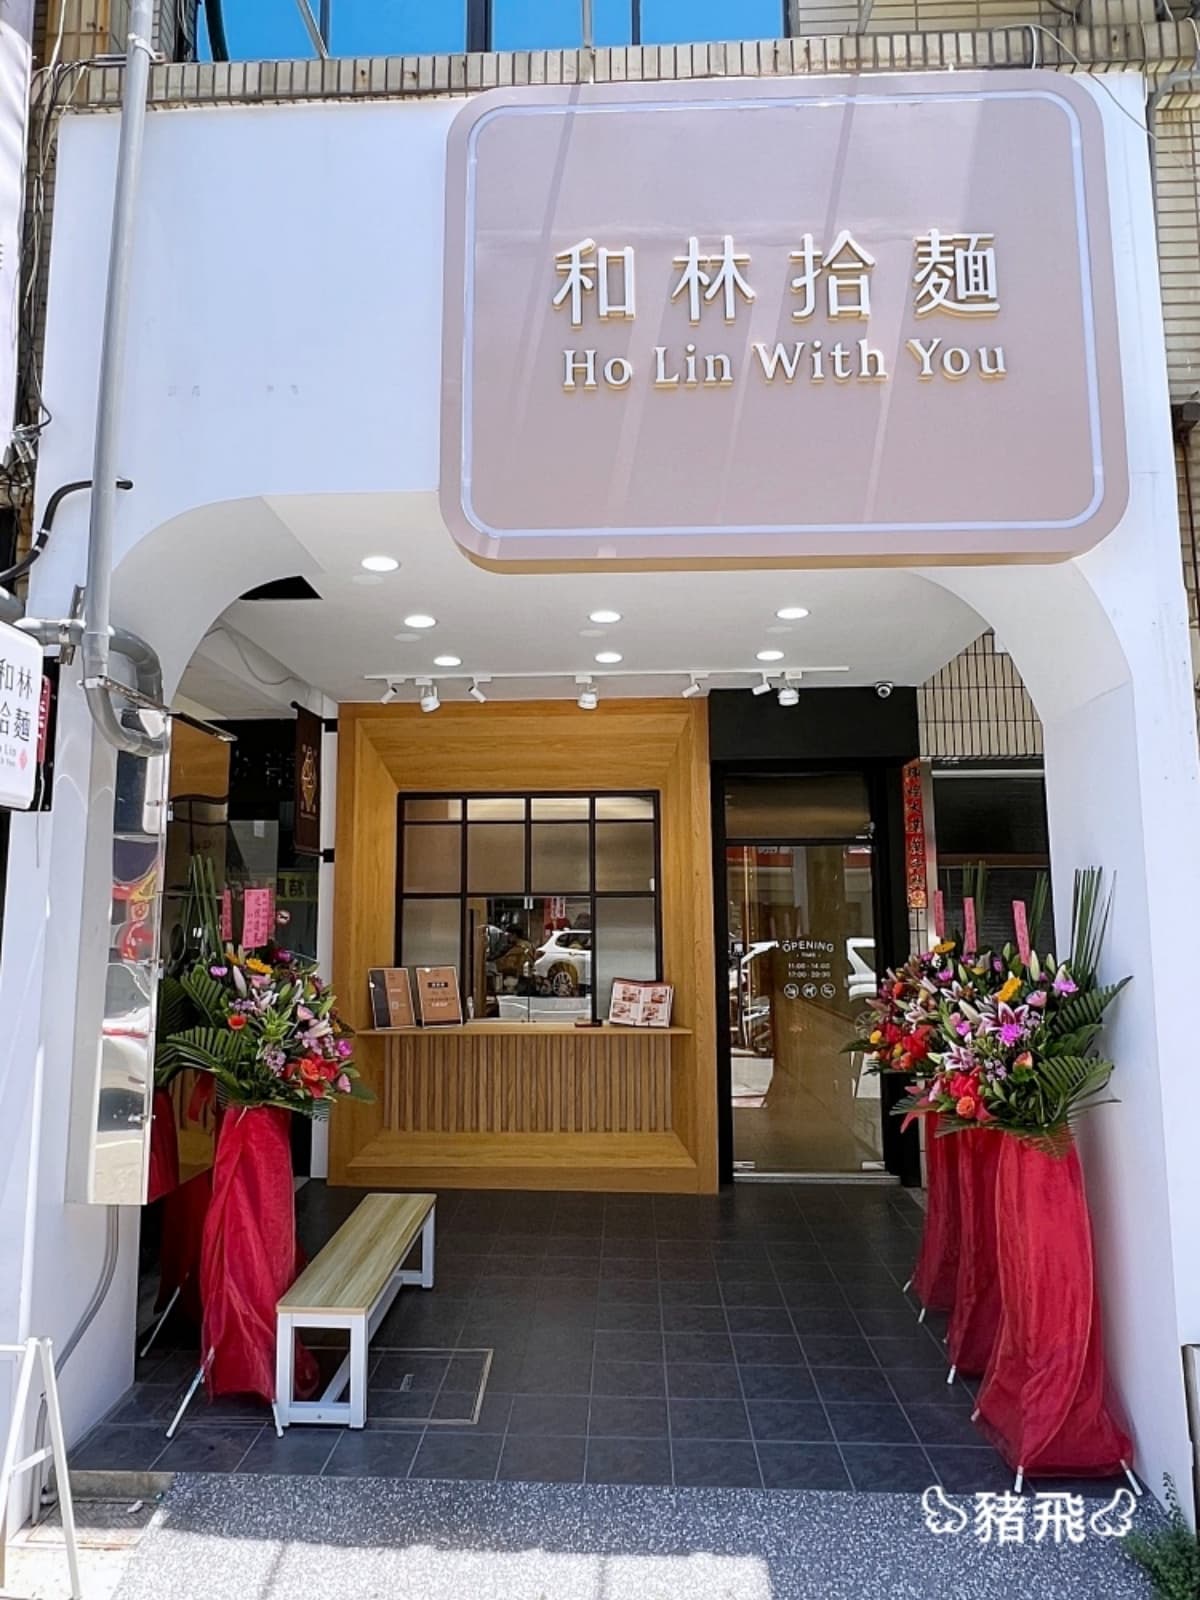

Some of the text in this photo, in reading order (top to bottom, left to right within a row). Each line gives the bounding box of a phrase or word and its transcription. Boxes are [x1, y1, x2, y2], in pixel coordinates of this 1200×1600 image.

[553, 229, 1000, 327] 和林拾麵
[563, 337, 1008, 390] Ho Lin With You
[782, 940, 834, 953] OPENING
